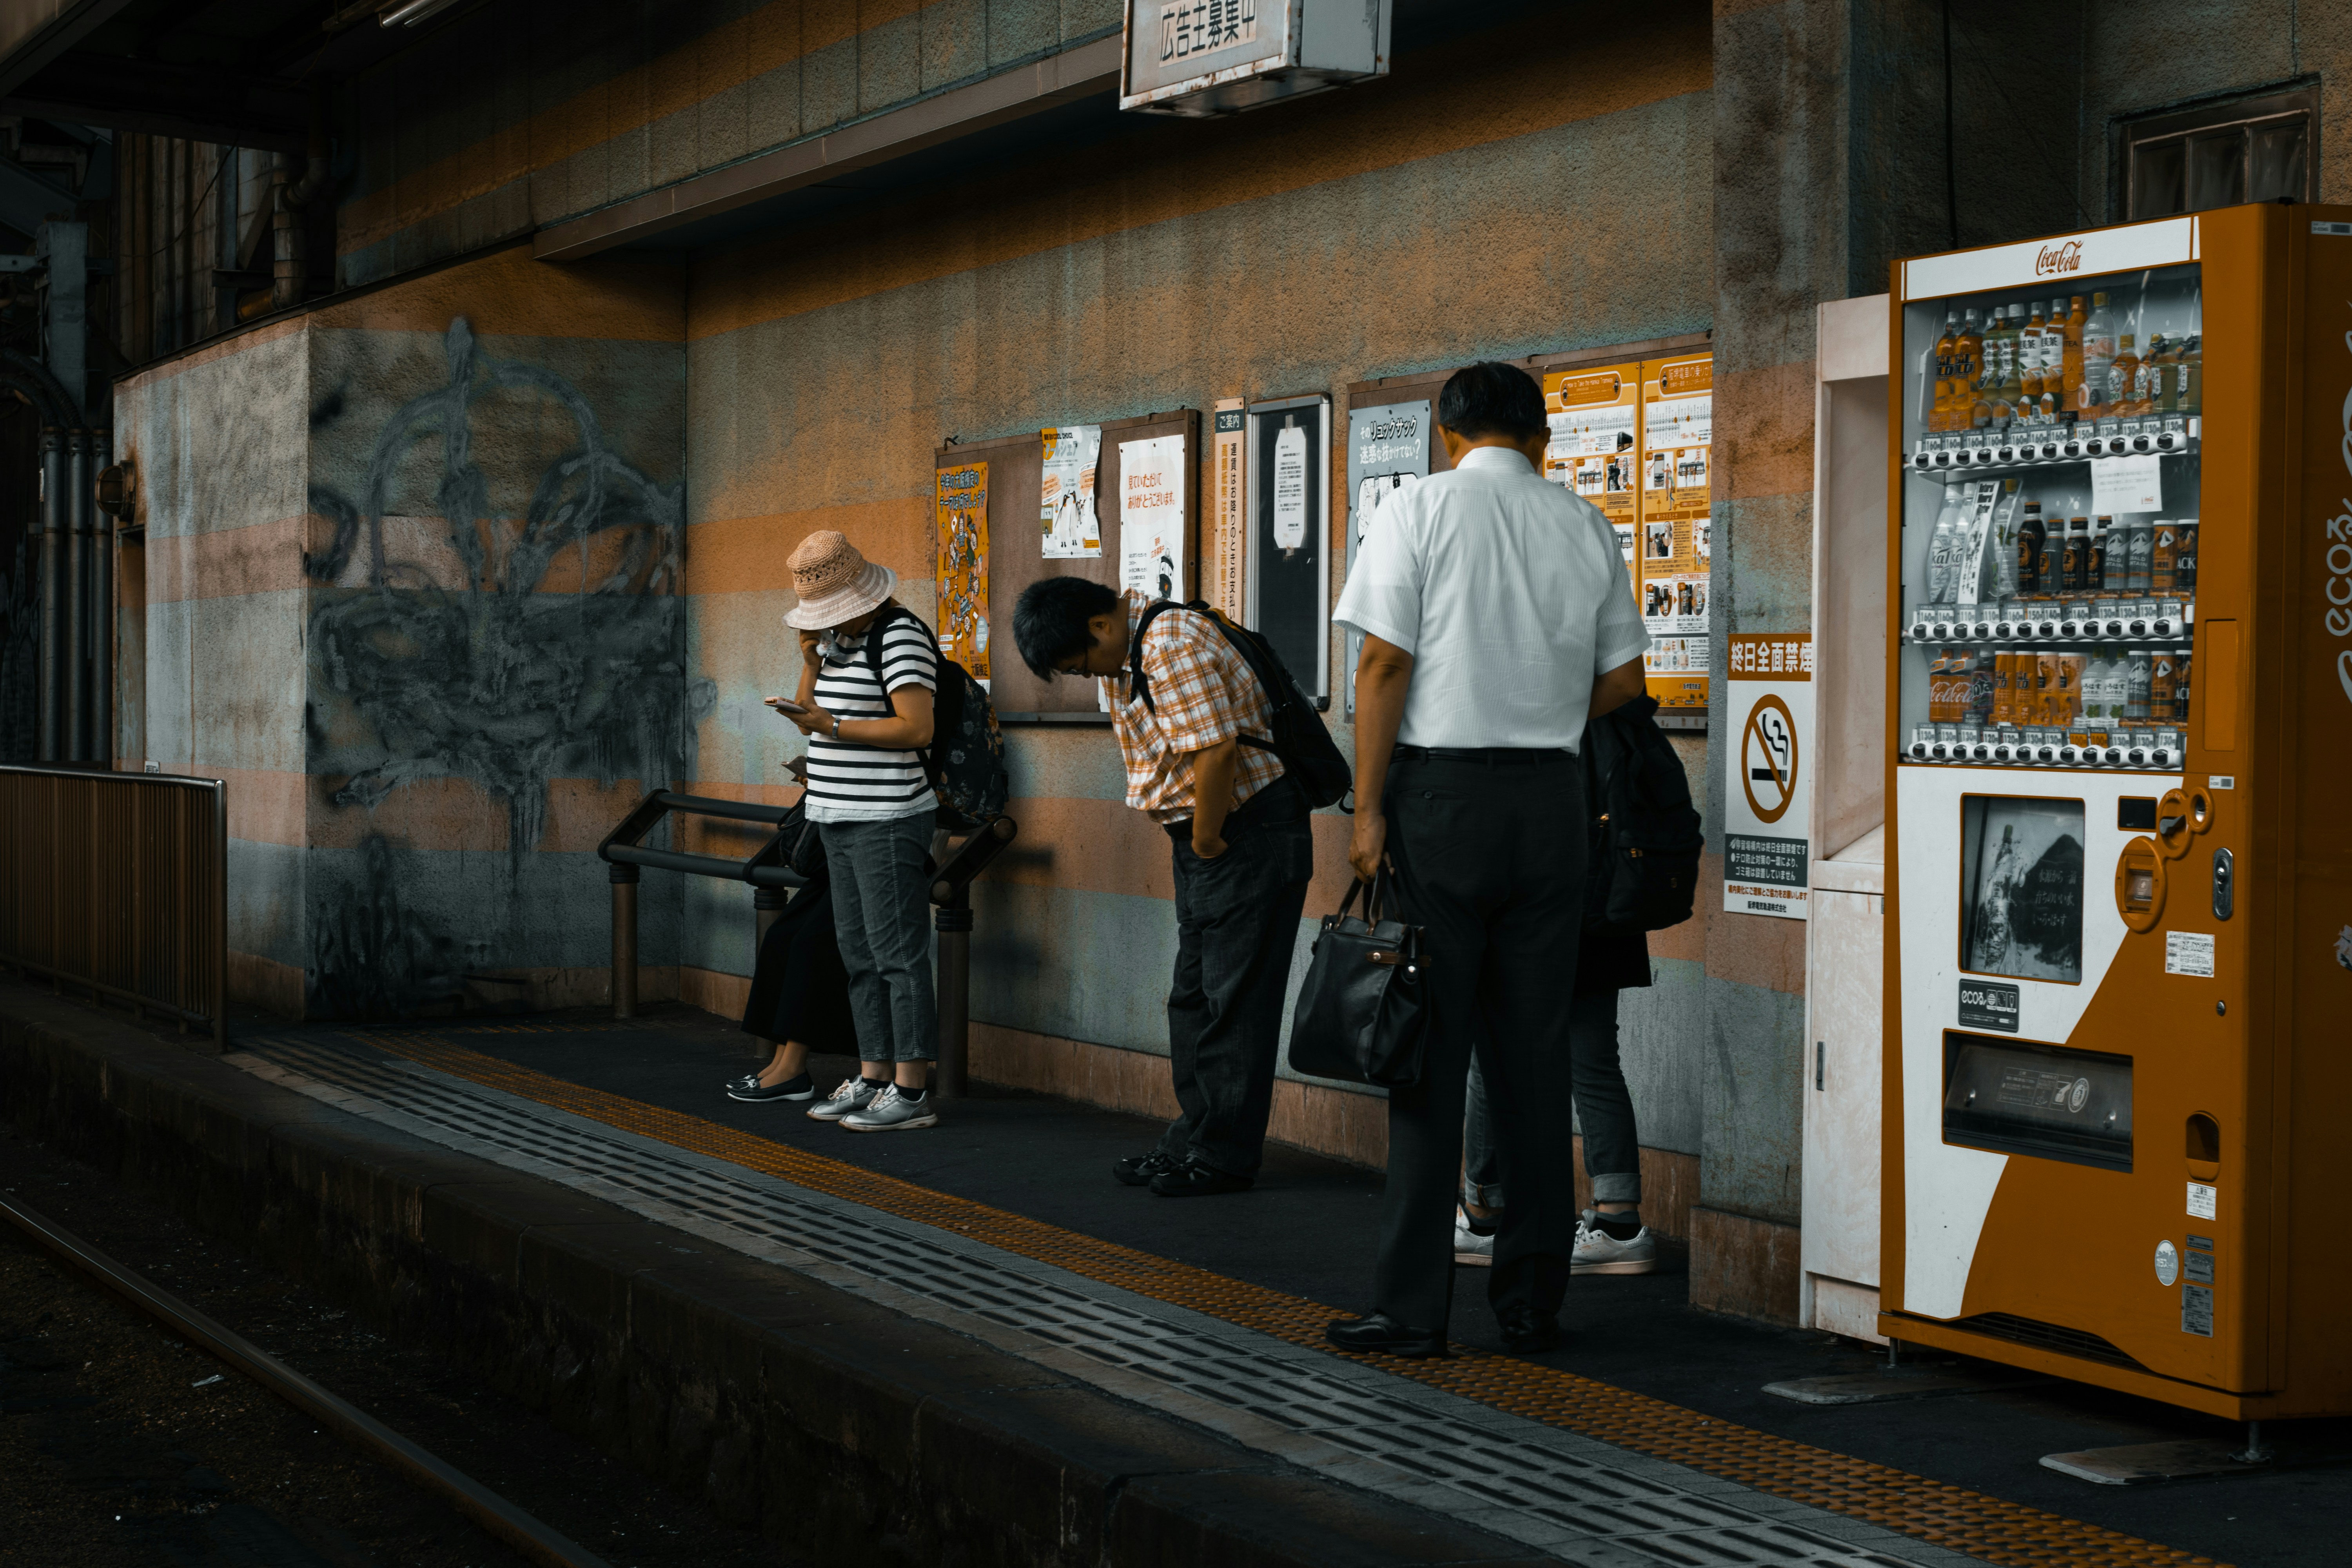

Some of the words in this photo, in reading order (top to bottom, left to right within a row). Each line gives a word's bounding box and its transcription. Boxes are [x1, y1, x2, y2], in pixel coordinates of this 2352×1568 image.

[1160, 0, 1255, 61] 広告主募集中
[1220, 414, 1239, 428] ご案内
[1360, 415, 1417, 441] そのリュックサック
[1128, 472, 1162, 490] 見ていただいて
[1127, 490, 1175, 509] ありがとうございます。
[1731, 641, 1812, 673] 終日全面禁煙
[1735, 866, 1796, 881] ゴミ箱は設置していません
